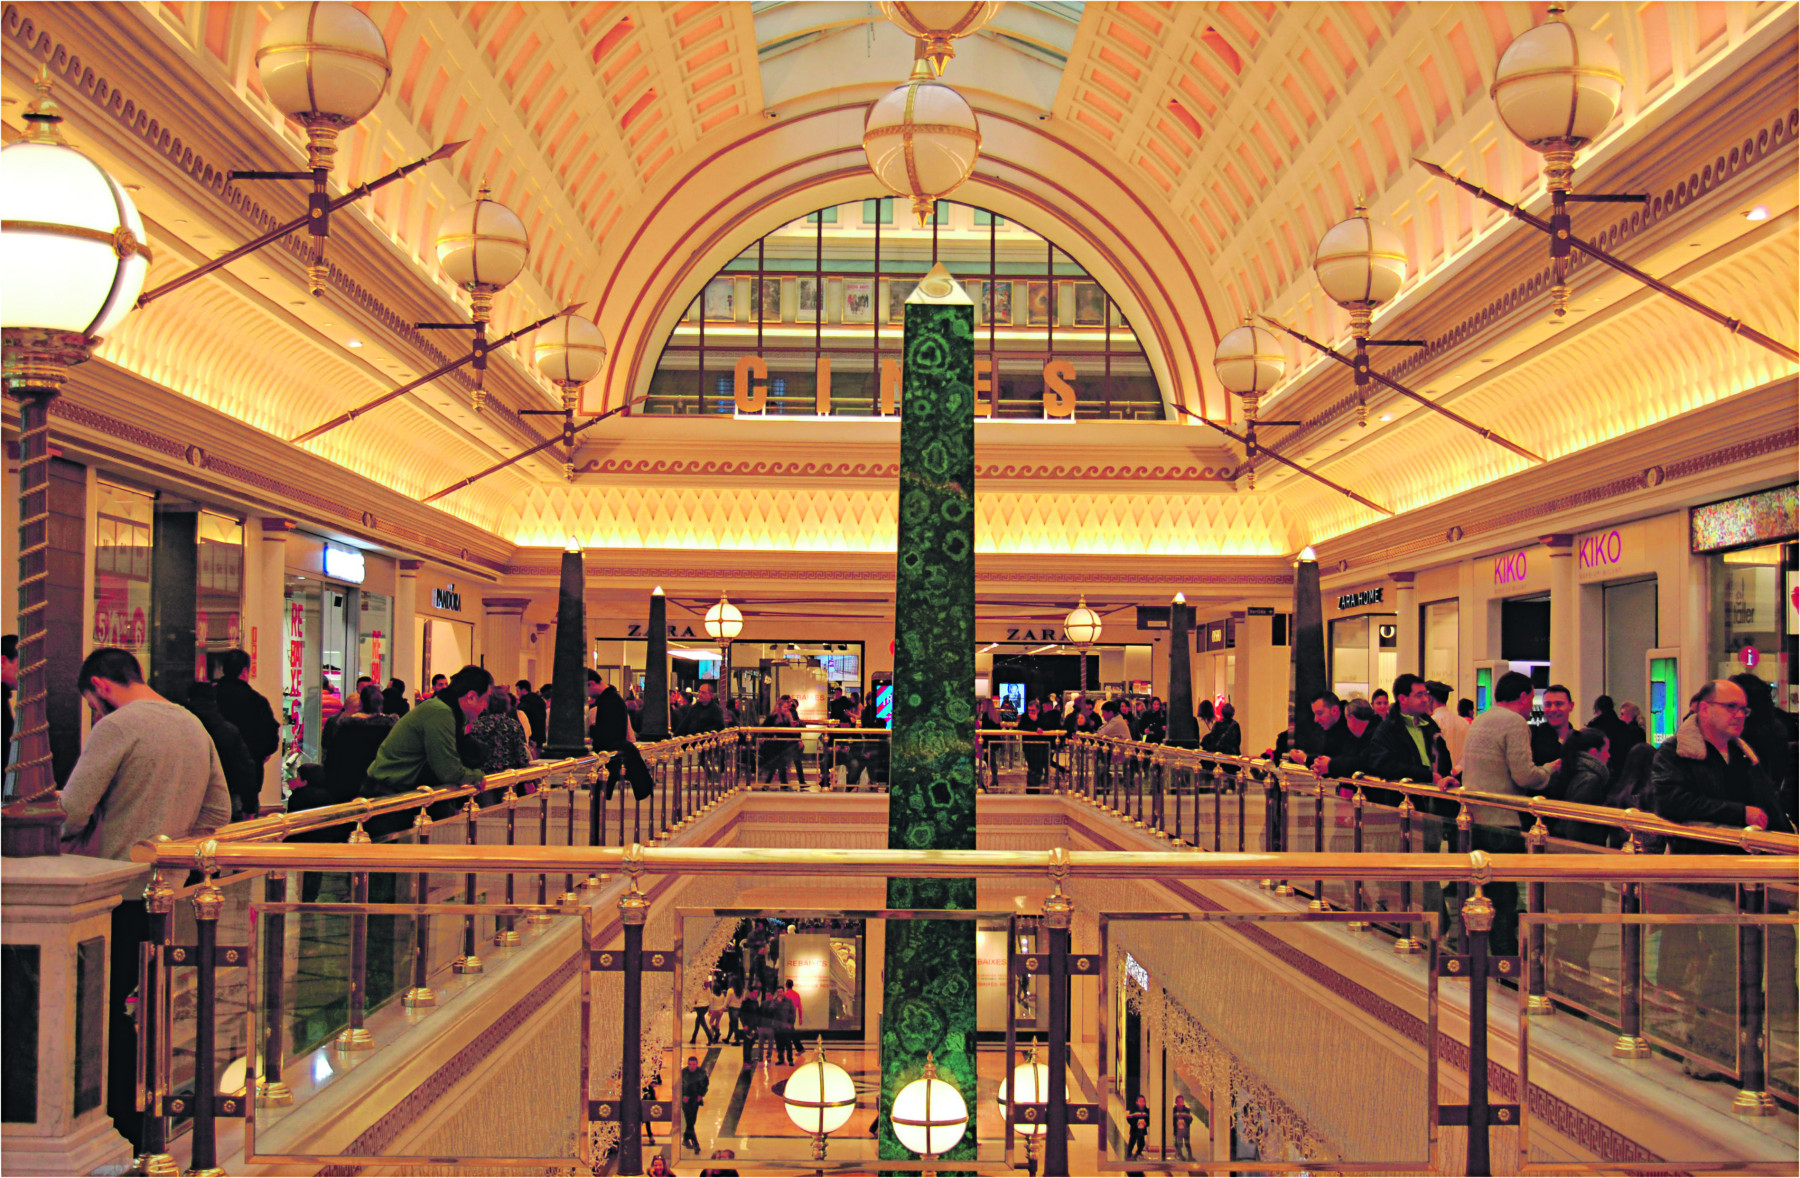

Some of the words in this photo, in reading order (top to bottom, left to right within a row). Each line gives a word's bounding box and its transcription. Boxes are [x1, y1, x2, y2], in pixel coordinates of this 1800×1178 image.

[734, 355, 1076, 417] CINES
[1578, 530, 1621, 569] KIKO
[1494, 551, 1527, 585] KIKO
[1337, 594, 1358, 611] ZARA
[1358, 587, 1384, 606] HOME
[627, 624, 697, 637] ZRA
